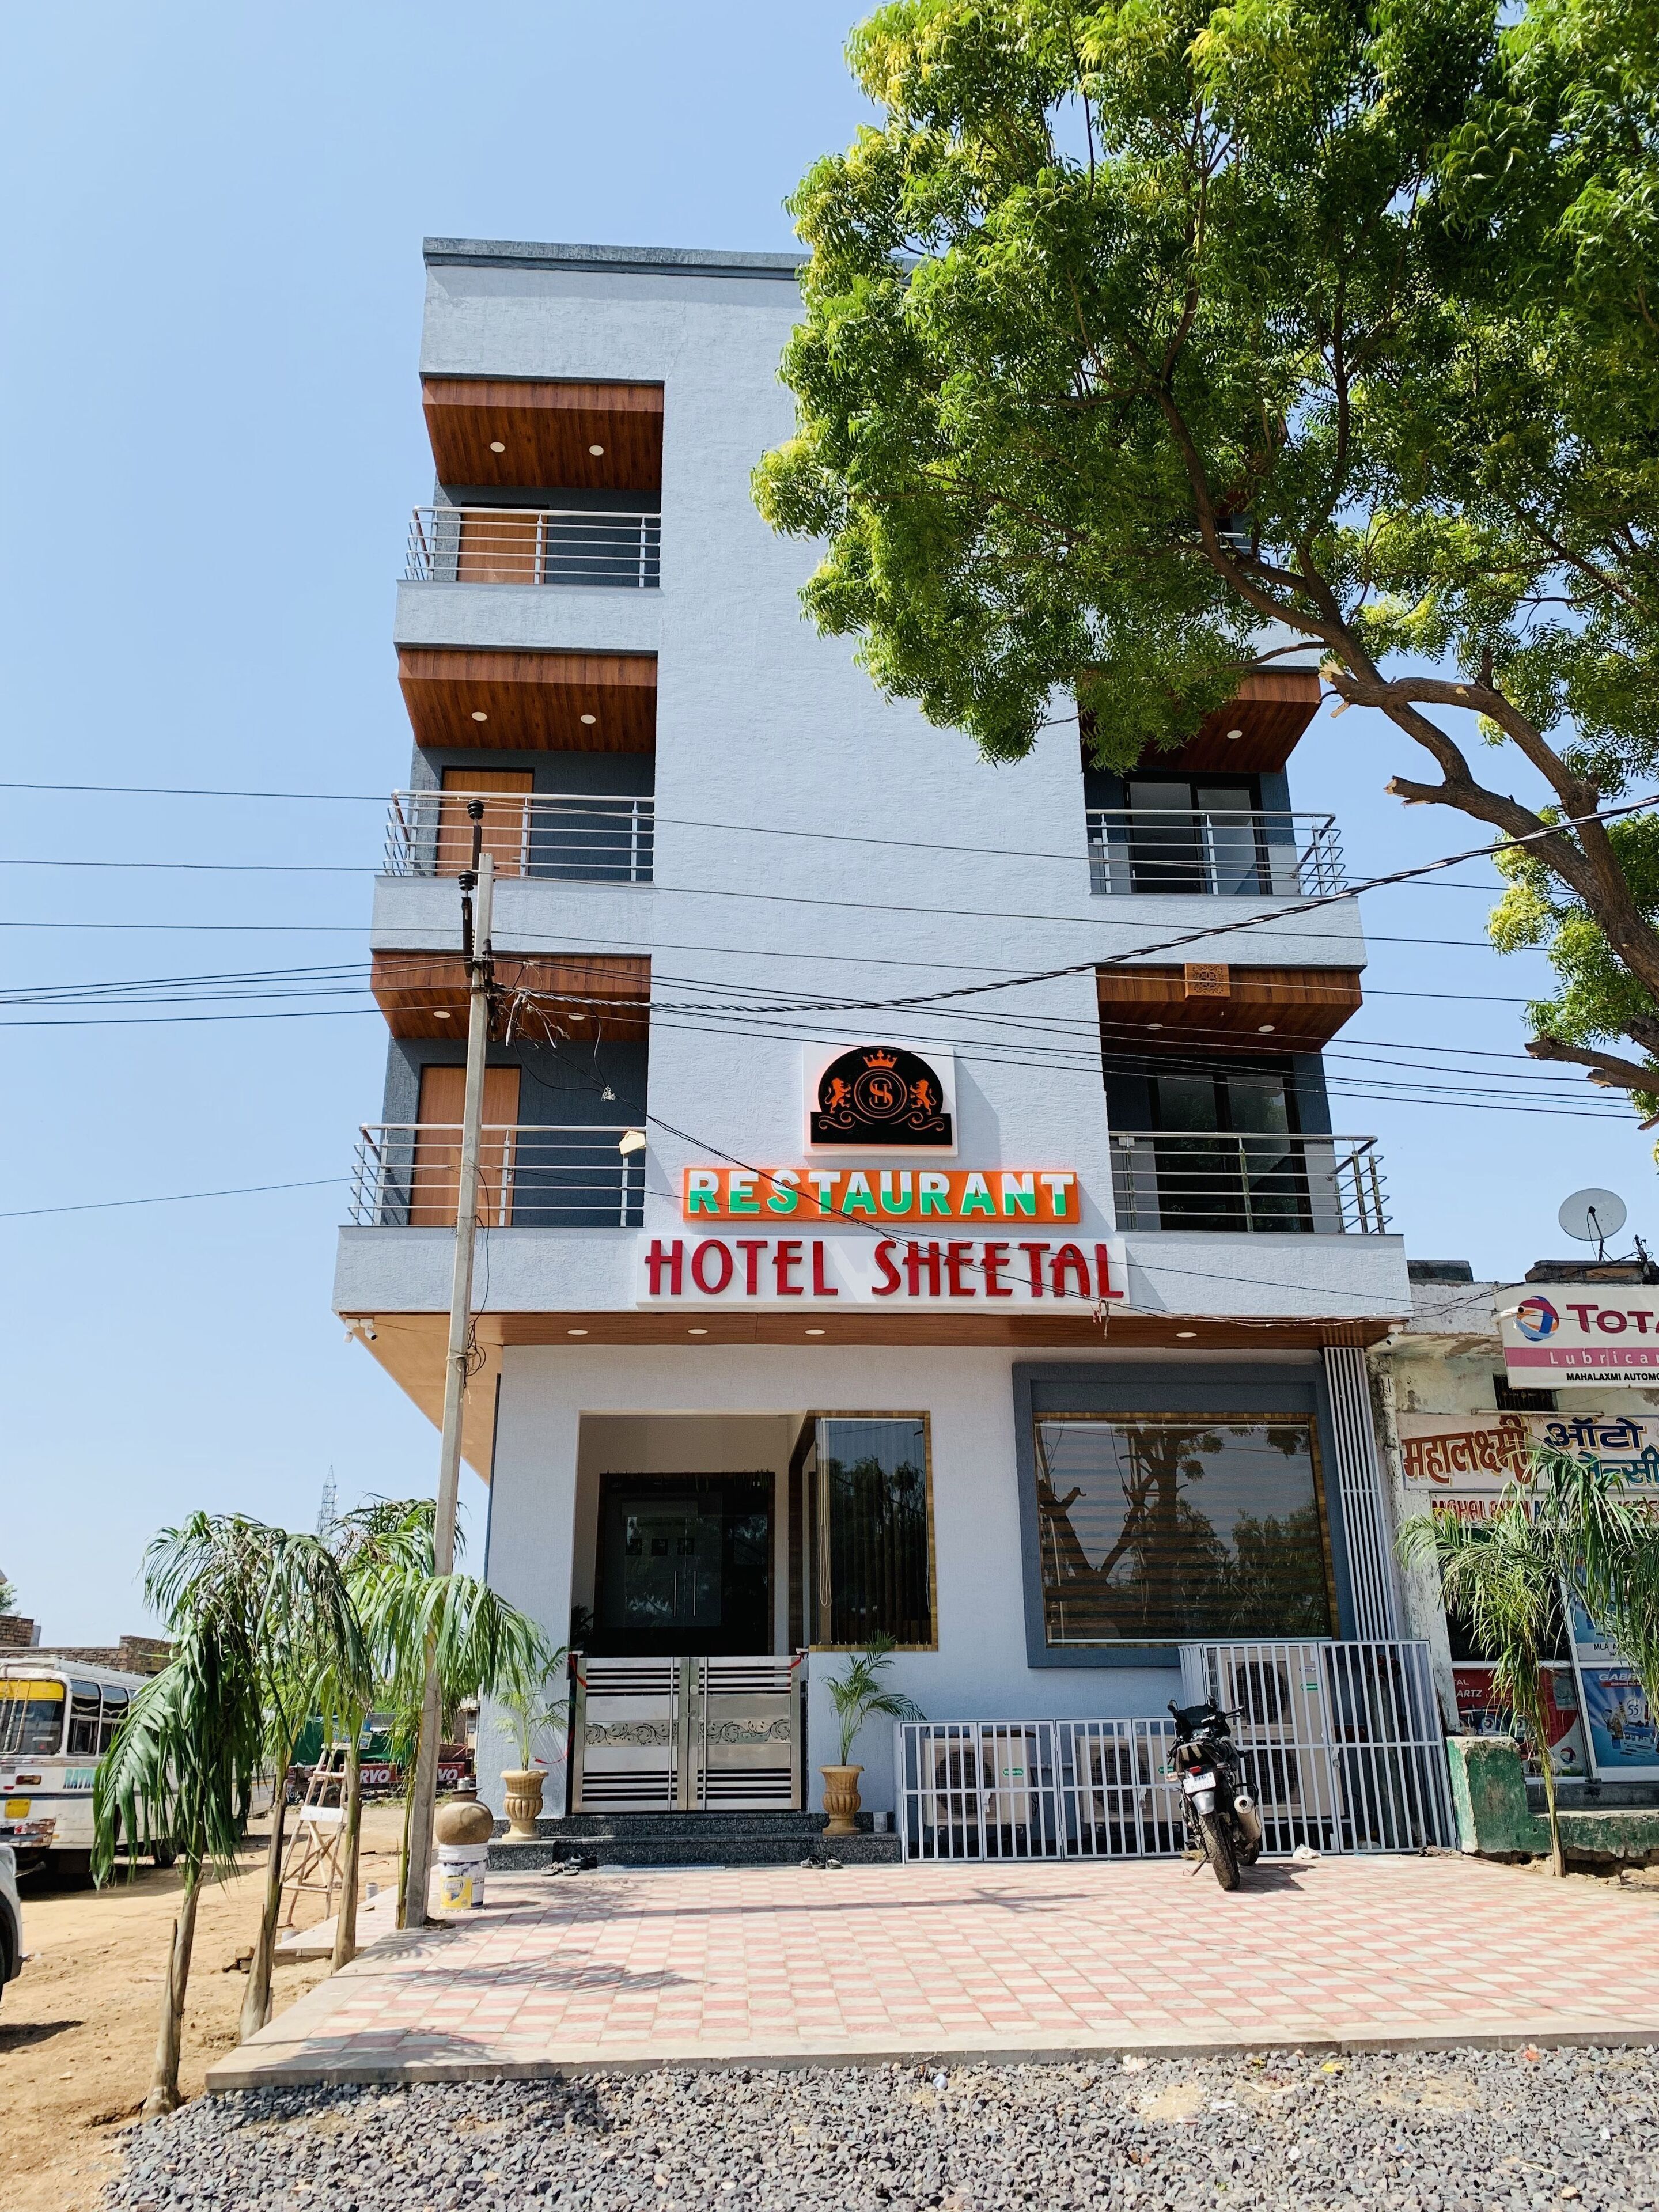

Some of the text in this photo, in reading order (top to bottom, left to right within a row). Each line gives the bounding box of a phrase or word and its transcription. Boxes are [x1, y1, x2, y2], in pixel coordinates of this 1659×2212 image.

[688, 1169, 1075, 1217] RESTAURANT
[645, 1238, 1124, 1299] HOTEL SHEETAL
[1566, 1304, 1659, 1334] TOT
[1550, 1351, 1659, 1365] Lubrica
[1566, 1373, 1622, 1381] MAHALAXMI
[1401, 1415, 1645, 1484] महालक्ष्मी ऑटो
